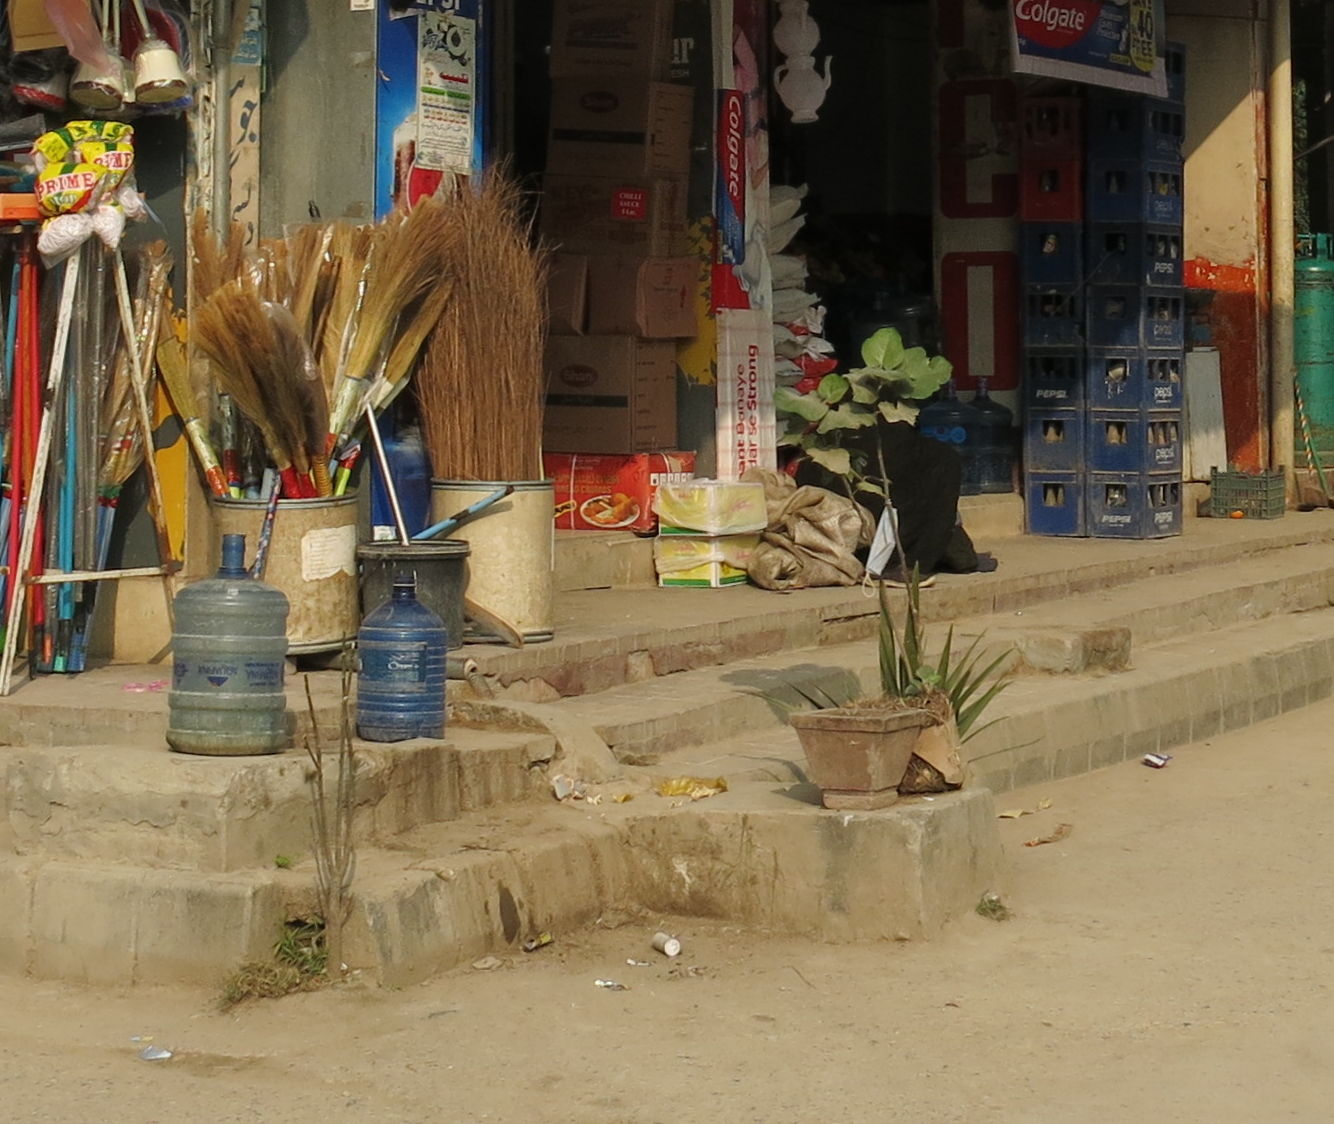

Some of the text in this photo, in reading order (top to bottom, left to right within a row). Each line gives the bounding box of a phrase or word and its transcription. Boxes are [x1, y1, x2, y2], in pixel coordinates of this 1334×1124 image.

[726, 95, 742, 198] Colgate
[37, 173, 94, 203] PRIME
[1154, 261, 1174, 274] PEPSI
[747, 344, 759, 411] Strong
[736, 364, 747, 435] Banaye
[748, 415, 758, 436] se
[1101, 515, 1132, 525] PEPSI
